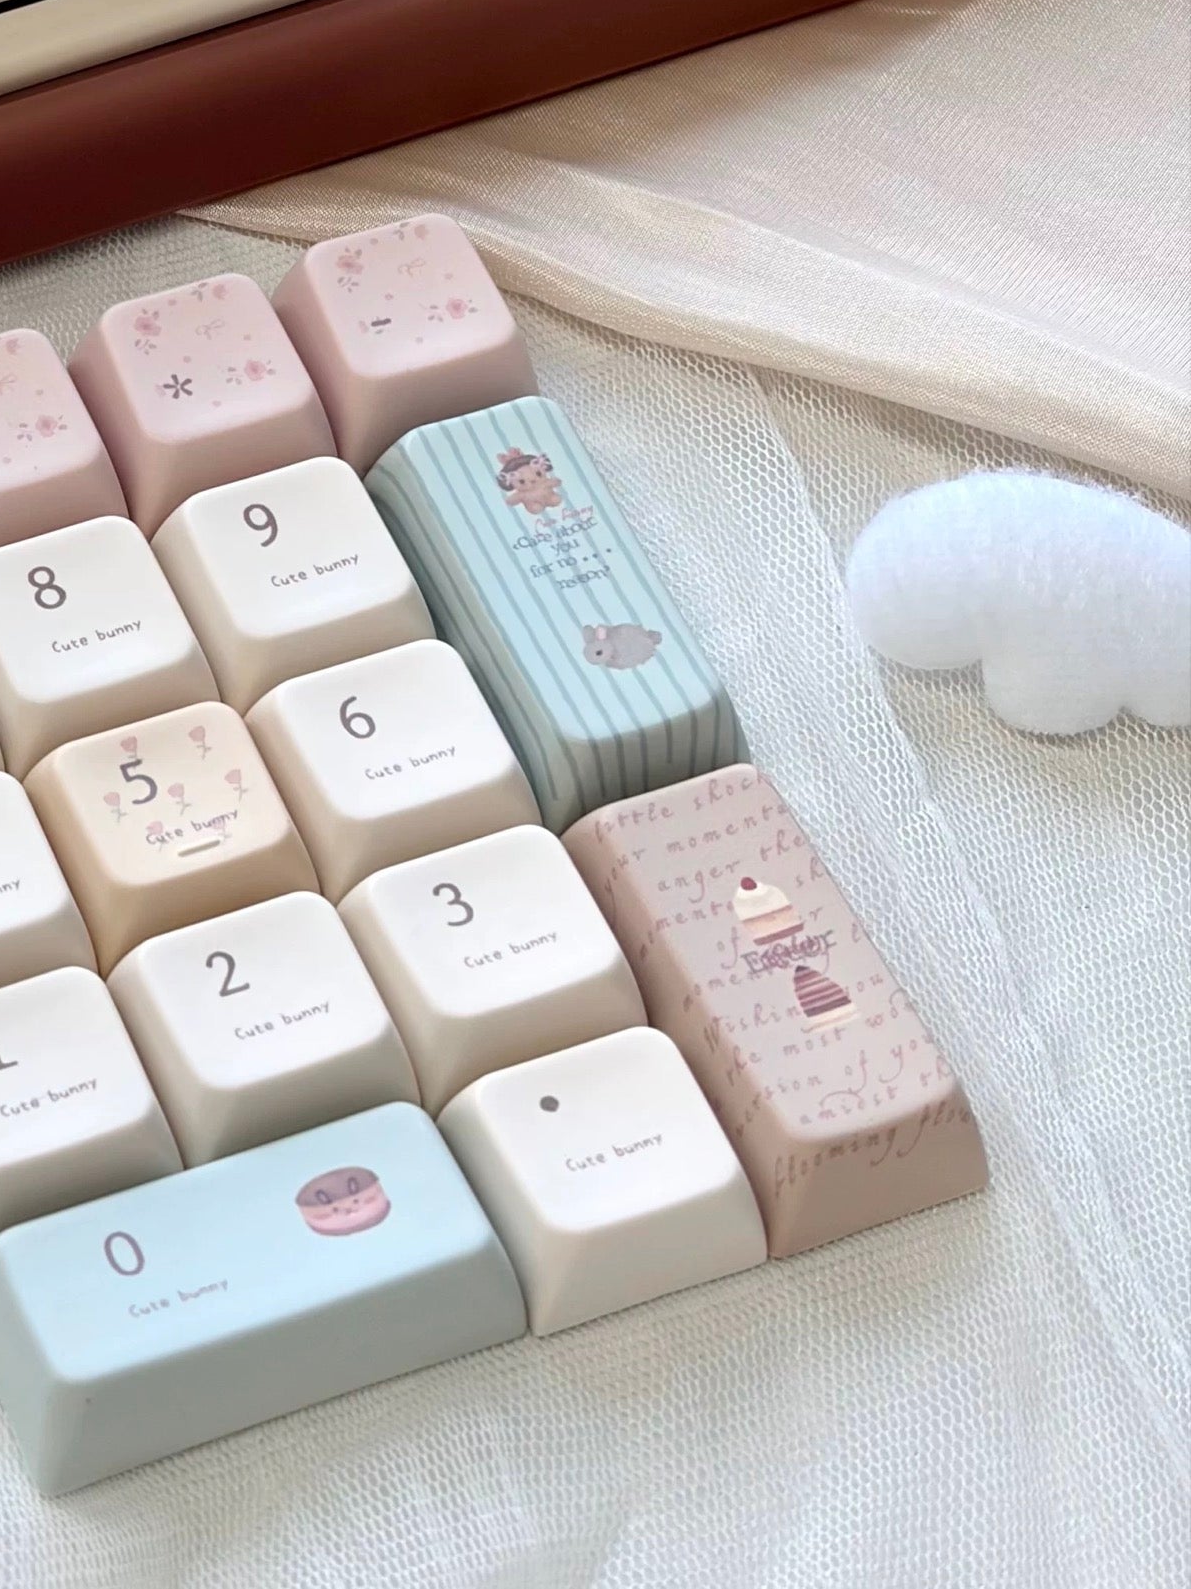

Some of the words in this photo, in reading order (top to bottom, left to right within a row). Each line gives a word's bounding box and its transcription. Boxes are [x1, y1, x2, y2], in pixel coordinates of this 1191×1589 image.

[242, 503, 279, 546] 9
[27, 567, 67, 610] 8
[271, 567, 307, 588] Cute
[314, 554, 359, 575] bunny
[51, 634, 89, 655] Cute
[95, 620, 141, 642] bunny
[340, 696, 376, 739] 6
[120, 759, 159, 805] 5
[364, 761, 403, 781] Cute
[411, 746, 456, 769] bunny
[146, 826, 185, 846] Cute
[191, 810, 239, 835] bunny
[431, 883, 474, 927] 3
[464, 948, 505, 969] Cute
[511, 932, 558, 957] bunny
[205, 951, 251, 997] 2
[234, 1021, 275, 1041] Cute
[282, 1001, 331, 1028] bunny
[0, 1097, 40, 1117] Cute
[47, 1079, 98, 1104] bunny
[566, 1152, 606, 1172] Cute
[611, 1133, 663, 1160] bunny
[103, 1231, 146, 1277] 0
[129, 1297, 169, 1318] Cute
[177, 1279, 229, 1305] bunny
